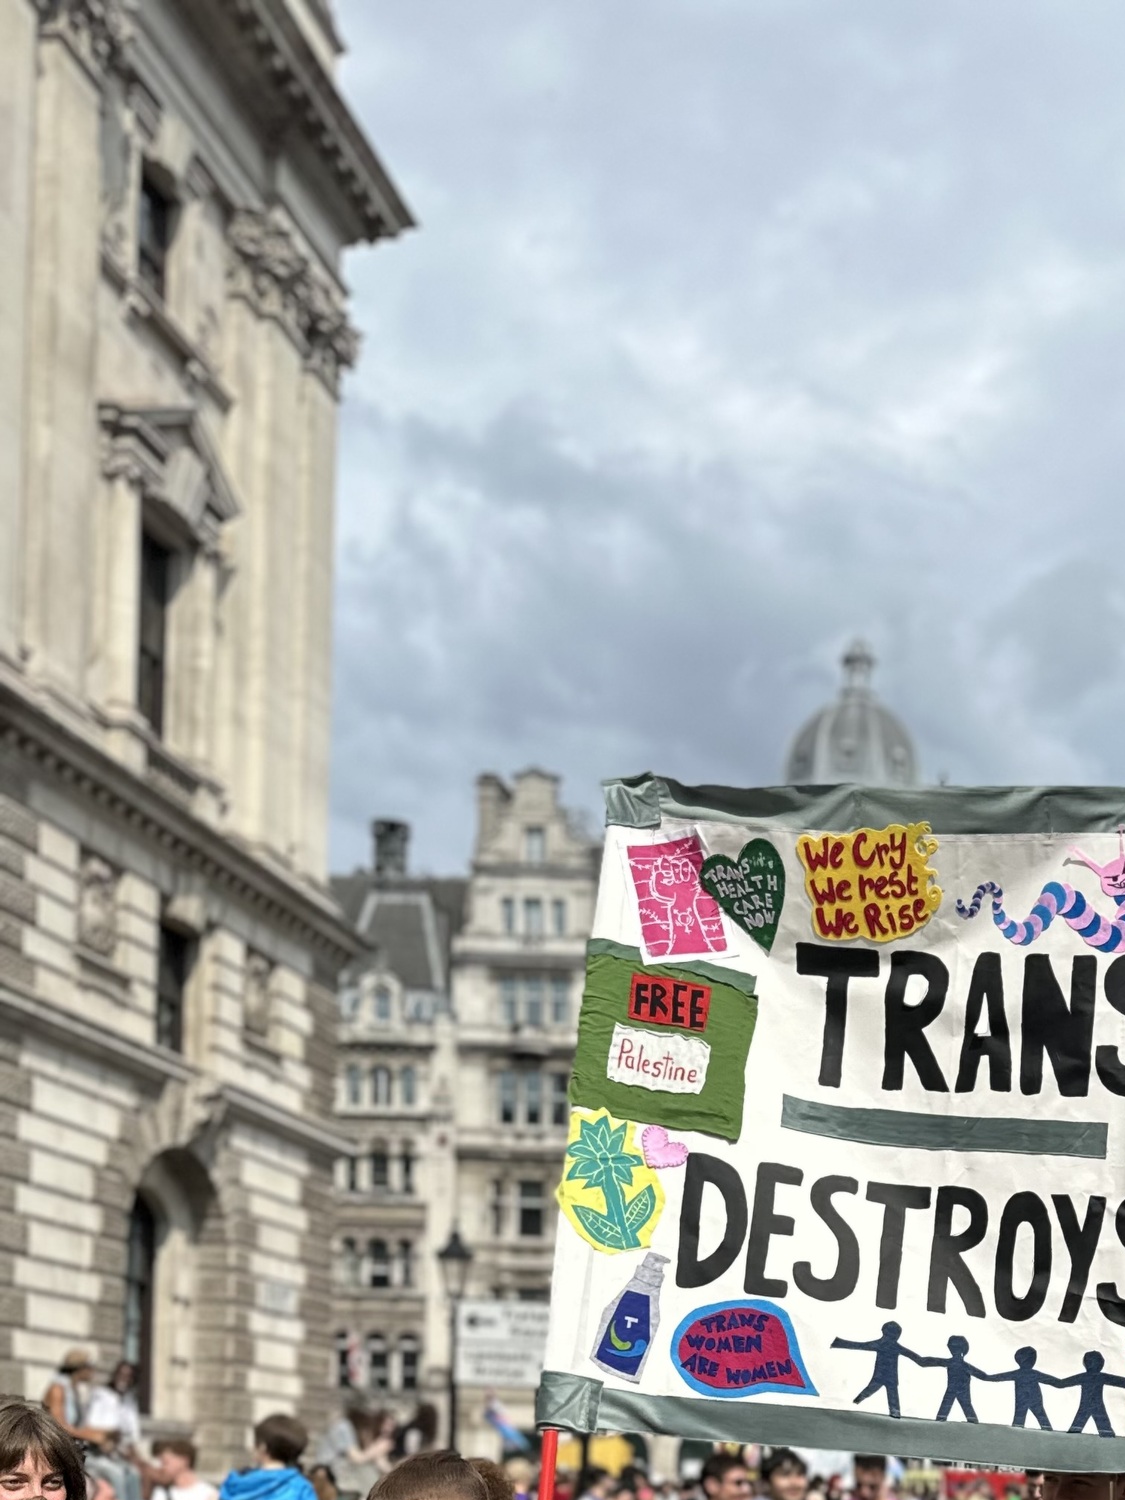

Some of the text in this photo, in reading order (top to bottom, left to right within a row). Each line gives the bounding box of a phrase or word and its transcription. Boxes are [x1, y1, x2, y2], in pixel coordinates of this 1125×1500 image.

[803, 837, 844, 872] We
[852, 832, 907, 869] Cry
[704, 857, 750, 884] TRANS
[810, 864, 919, 906] We rest
[715, 875, 778, 899] HEALTH
[733, 893, 773, 916] CARE
[815, 898, 929, 938] We Rise
[744, 909, 776, 931] NOW
[634, 982, 705, 1028] FREE
[617, 1038, 698, 1083] Palestine
[700, 1313, 769, 1333] TRANS
[686, 1334, 763, 1353] WOMEN
[680, 1354, 792, 1385] ARE WOMEN
